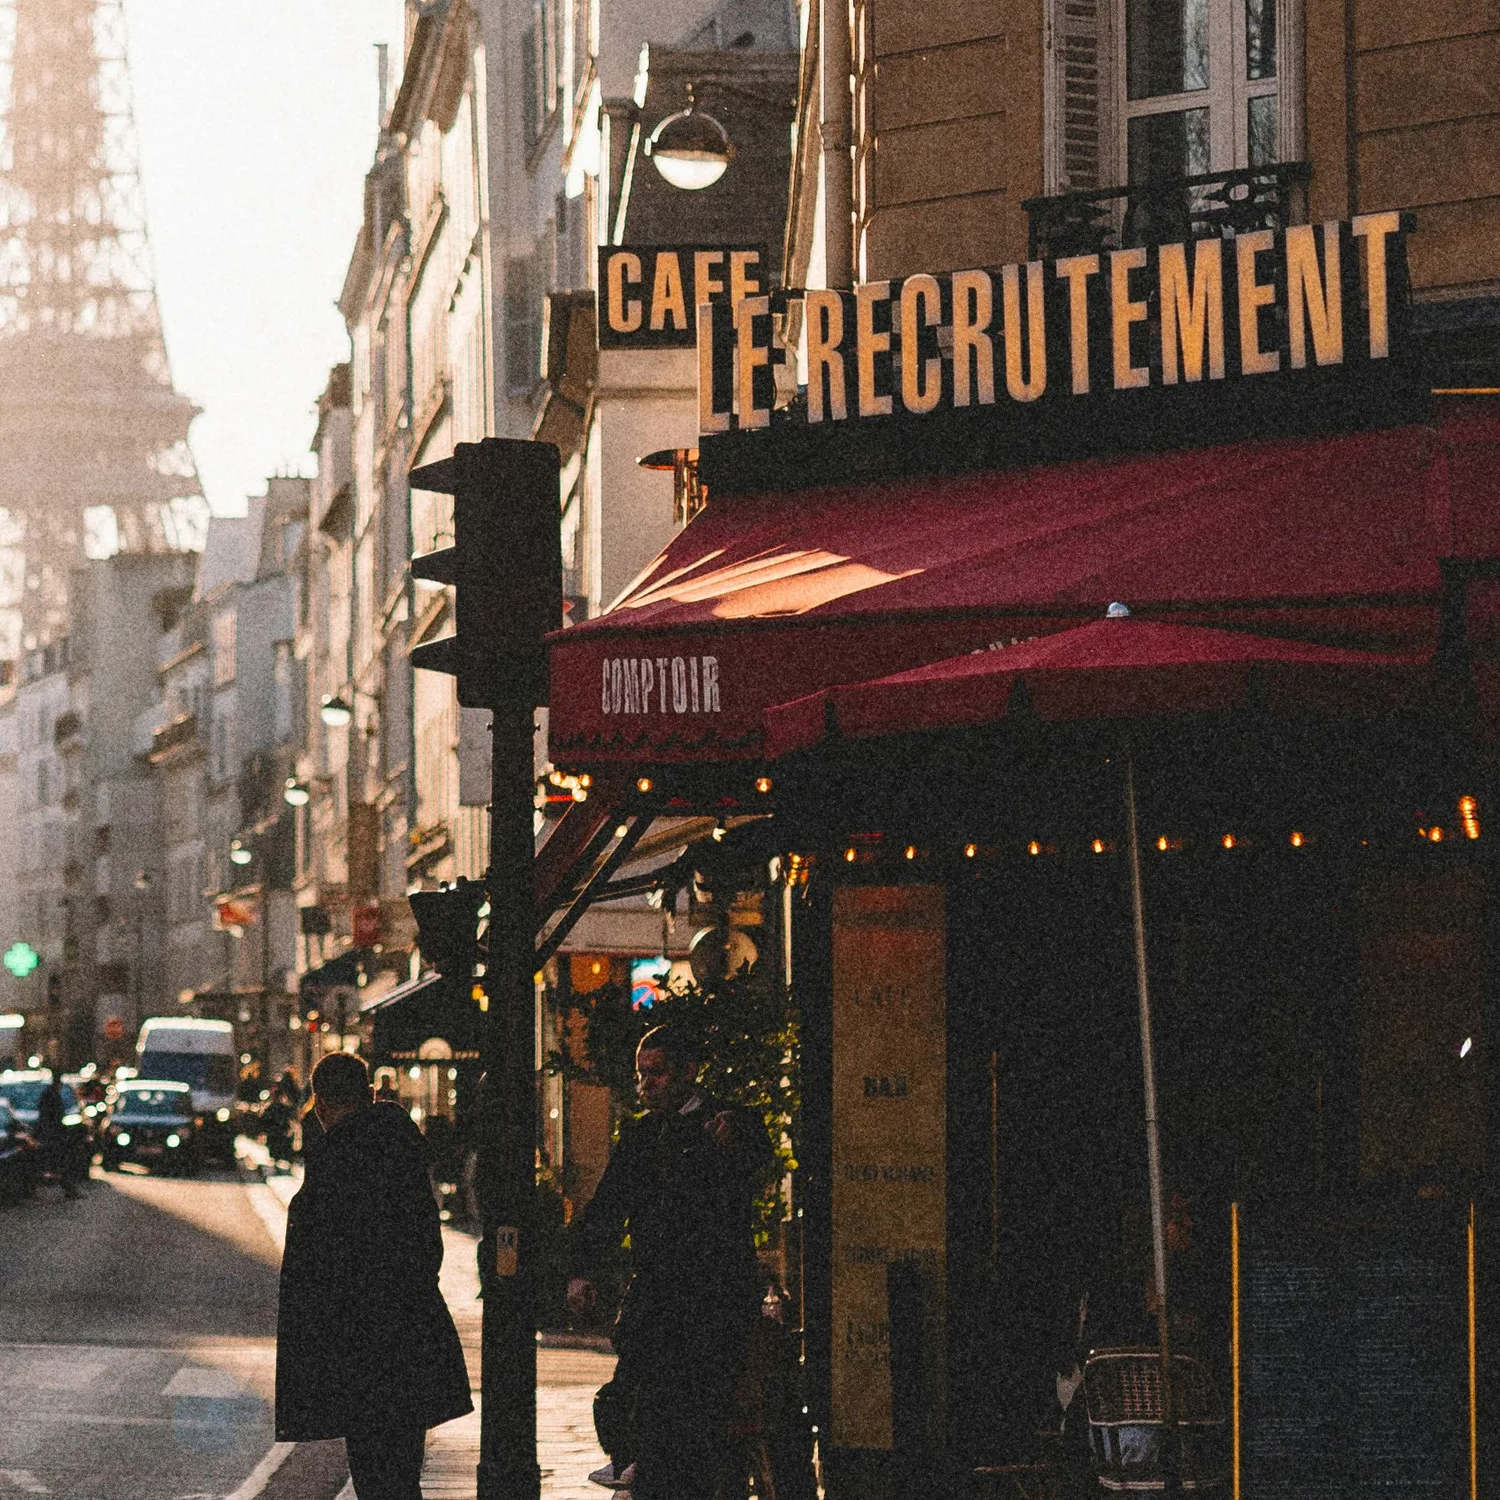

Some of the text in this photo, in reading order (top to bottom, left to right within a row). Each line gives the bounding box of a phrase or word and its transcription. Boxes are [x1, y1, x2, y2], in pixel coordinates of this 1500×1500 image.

[699, 211, 1400, 431] LE RECRUTEMENT
[601, 655, 722, 714] COMPTOIR
